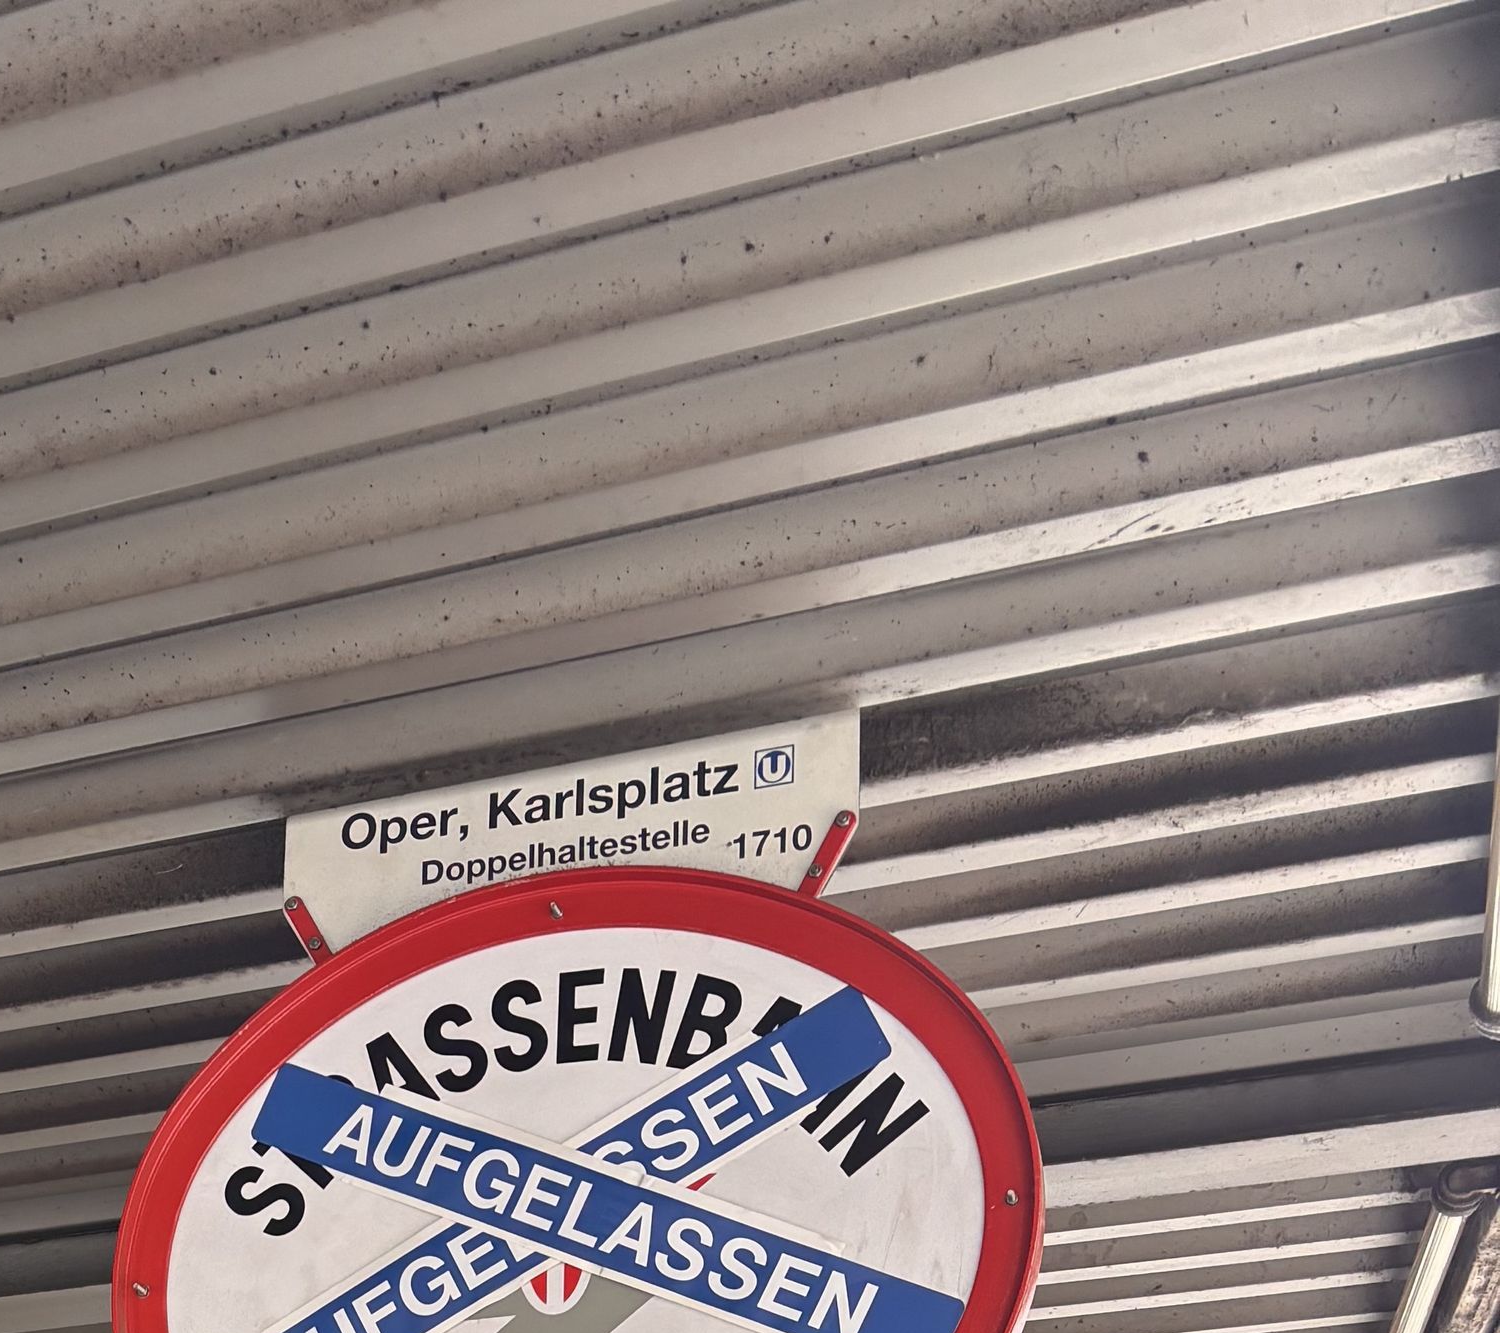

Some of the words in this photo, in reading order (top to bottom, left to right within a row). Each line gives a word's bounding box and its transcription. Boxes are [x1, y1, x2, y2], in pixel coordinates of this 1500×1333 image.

[341, 807, 470, 857] Oper,
[488, 760, 740, 830] Karlsplatz
[421, 819, 711, 886] Doppelhaltestelle
[732, 824, 812, 860] 1710
